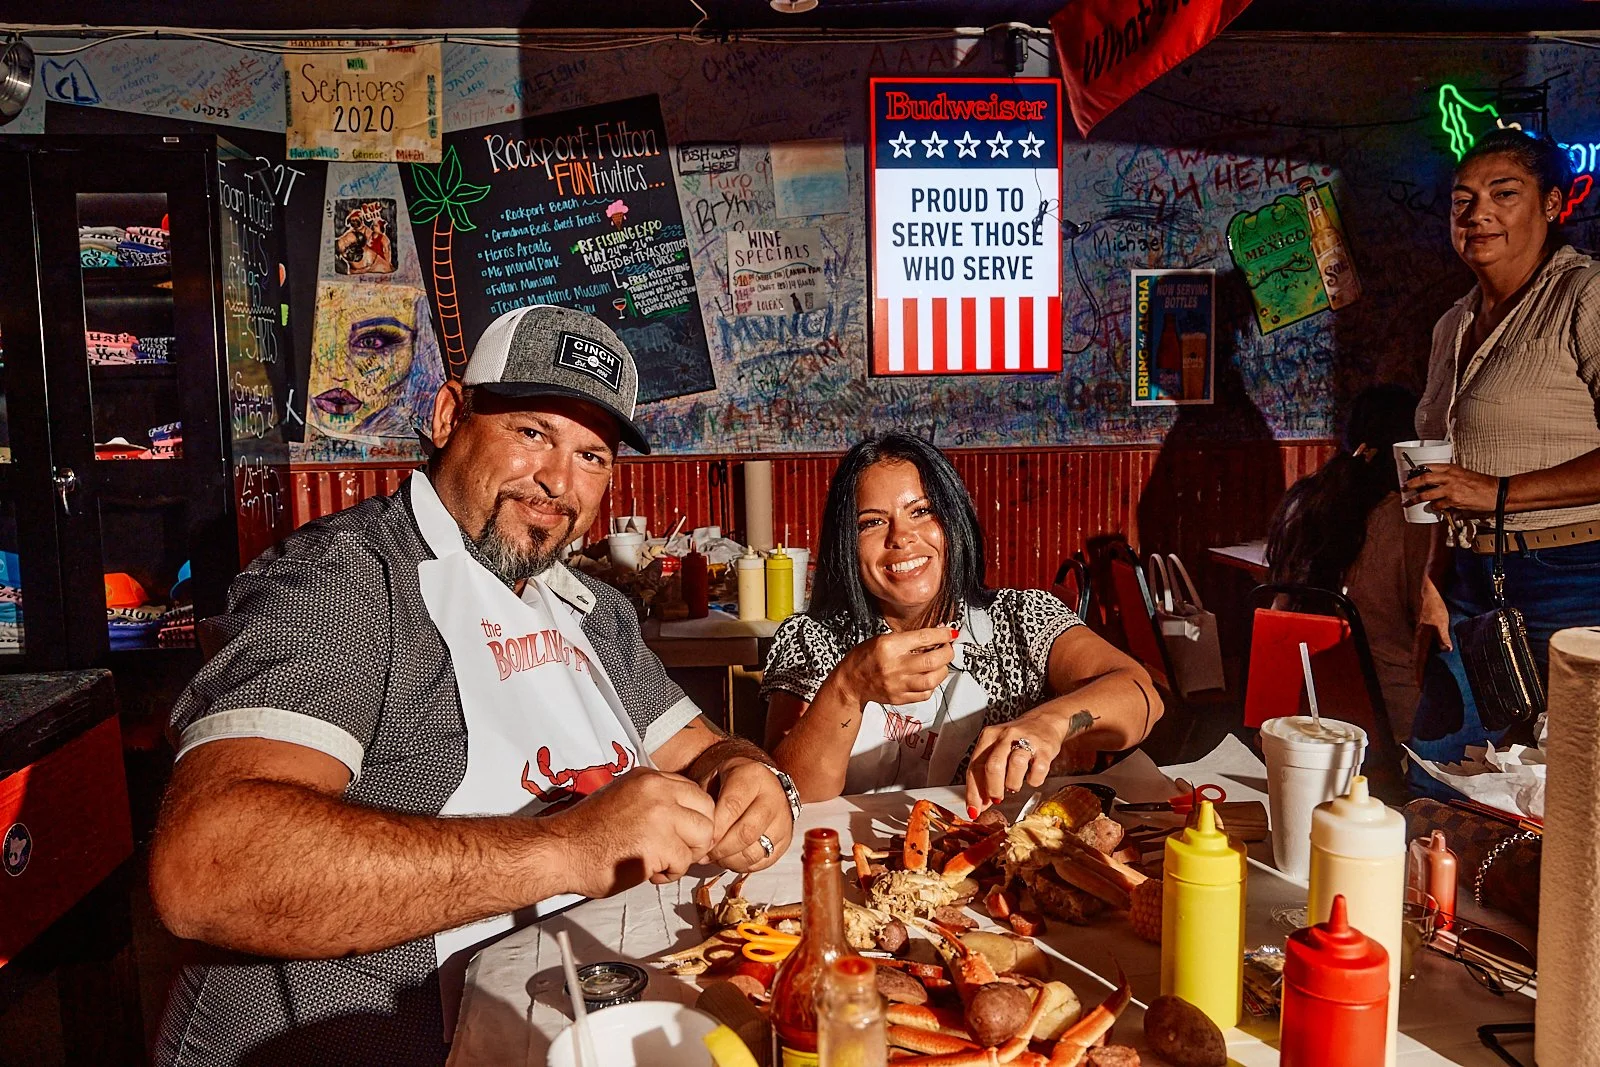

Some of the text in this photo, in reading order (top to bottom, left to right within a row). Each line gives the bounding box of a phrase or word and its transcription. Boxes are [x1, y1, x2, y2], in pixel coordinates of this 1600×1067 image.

[301, 63, 405, 102] Seniors
[884, 90, 1048, 122] Budweiser
[333, 105, 394, 133] 2020
[505, 198, 579, 221] Rockport Beach
[911, 187, 1024, 213] PROUD TO
[575, 212, 602, 227] Treats
[577, 220, 662, 253] RF FISHING EXPO
[748, 231, 782, 249] WINE
[892, 222, 1043, 247] SERVE THOSE
[1093, 229, 1165, 258] Michael
[1244, 229, 1307, 261] MEXICO
[517, 239, 552, 257] Arcade
[583, 248, 607, 266] MAY
[590, 258, 623, 275] HOSTED
[623, 252, 635, 267] BY
[634, 245, 661, 263] TEXAS
[735, 244, 810, 268] SPECIALS
[536, 255, 563, 271] Park
[903, 256, 1033, 281] WHO SERVE
[573, 282, 612, 300] Museum
[1138, 278, 1150, 334] ALOHA
[573, 341, 615, 367] CINCH
[1137, 349, 1149, 398] BRING
[481, 618, 502, 638] the
